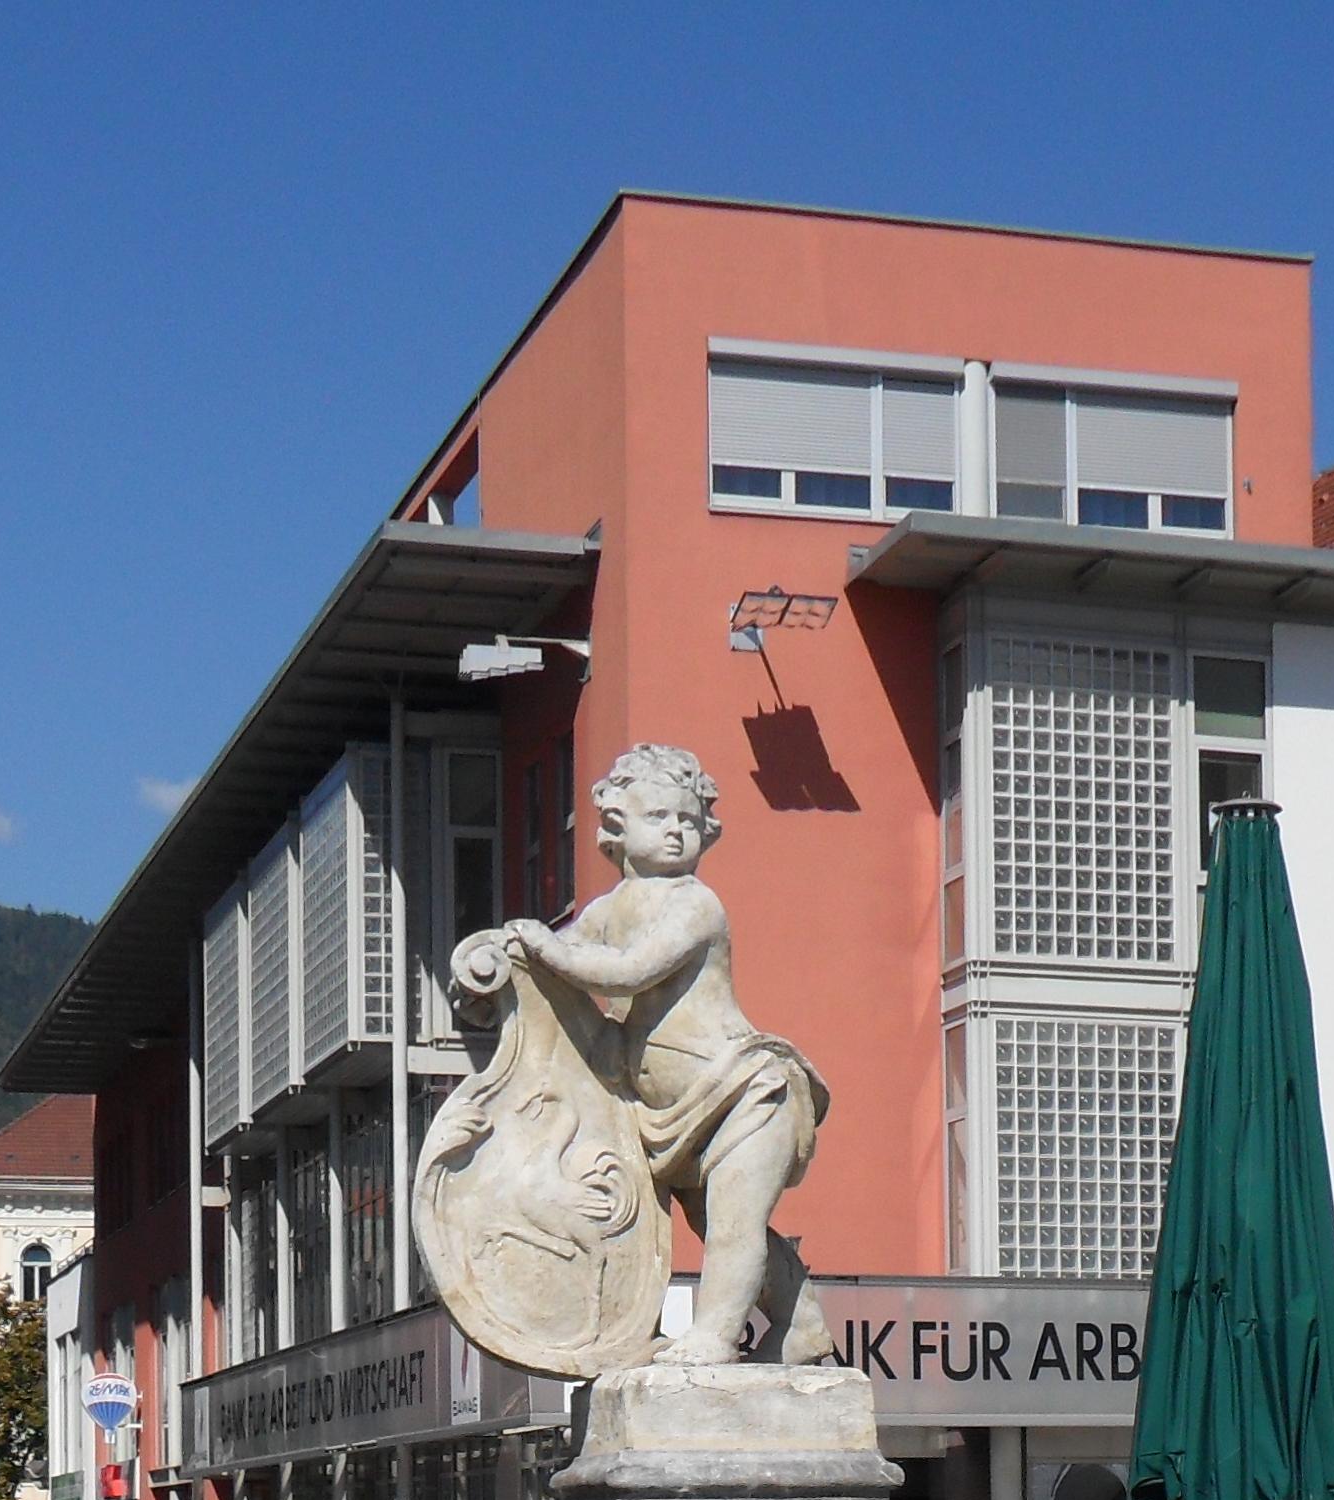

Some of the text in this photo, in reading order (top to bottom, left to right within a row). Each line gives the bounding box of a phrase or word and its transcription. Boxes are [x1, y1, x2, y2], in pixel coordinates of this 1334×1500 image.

[912, 1321, 1011, 1381] FÜR
[1029, 1322, 1143, 1381] ARB
[310, 1375, 335, 1424] UND
[339, 1350, 425, 1417] WIRTSCHAFT
